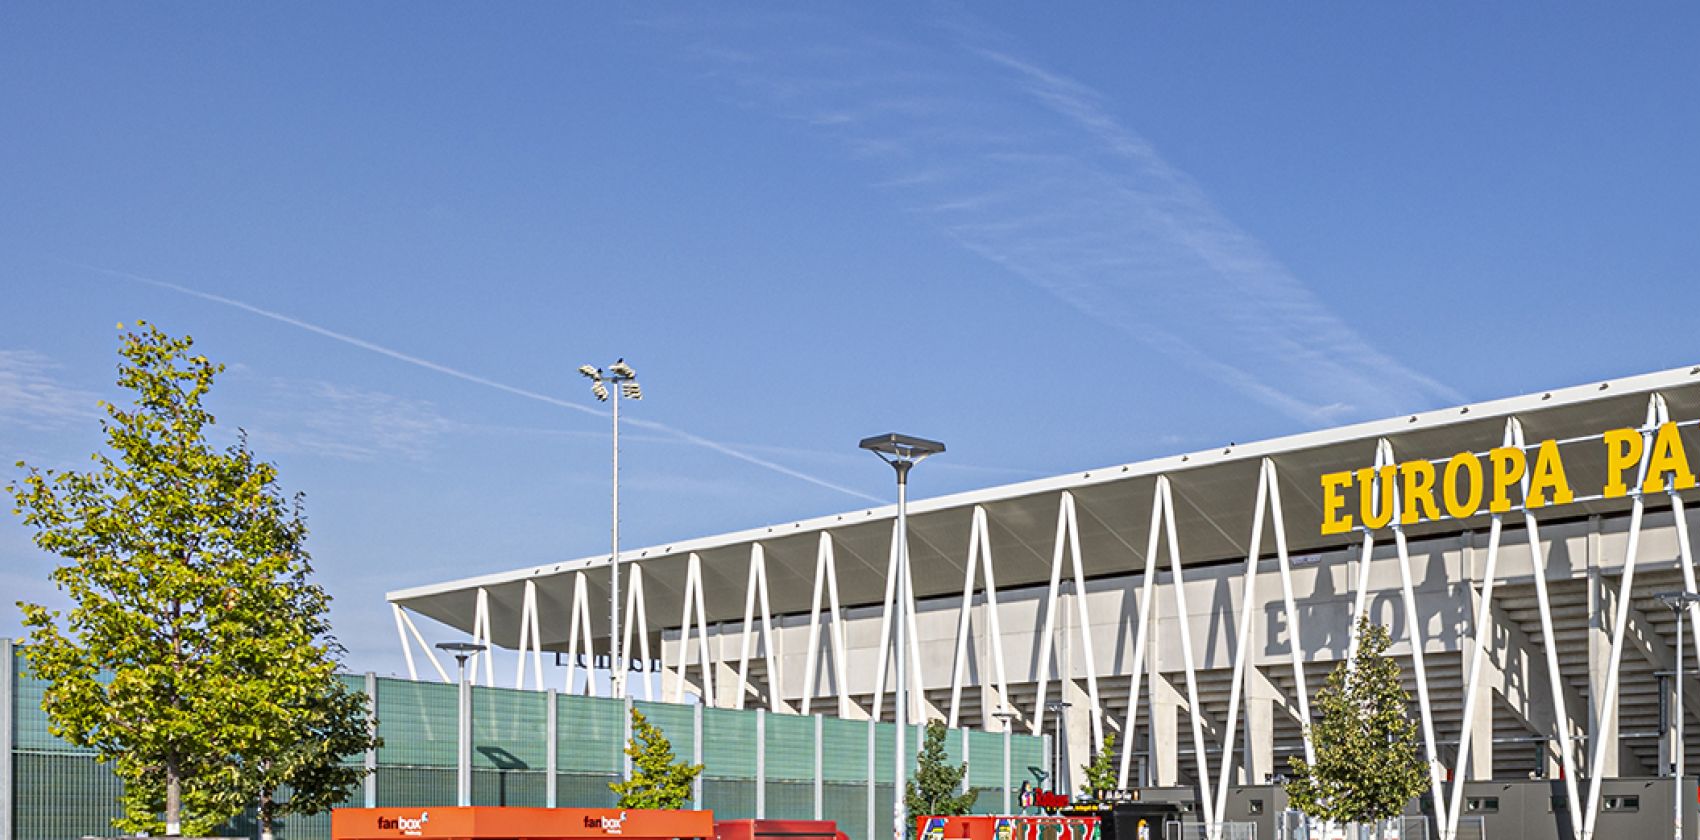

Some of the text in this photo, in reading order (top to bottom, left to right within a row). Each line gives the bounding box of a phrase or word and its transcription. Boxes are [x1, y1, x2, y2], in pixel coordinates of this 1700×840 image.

[1320, 438, 1574, 536] EUROPA
[377, 815, 422, 830] fanbox
[584, 815, 622, 829] fanbox
